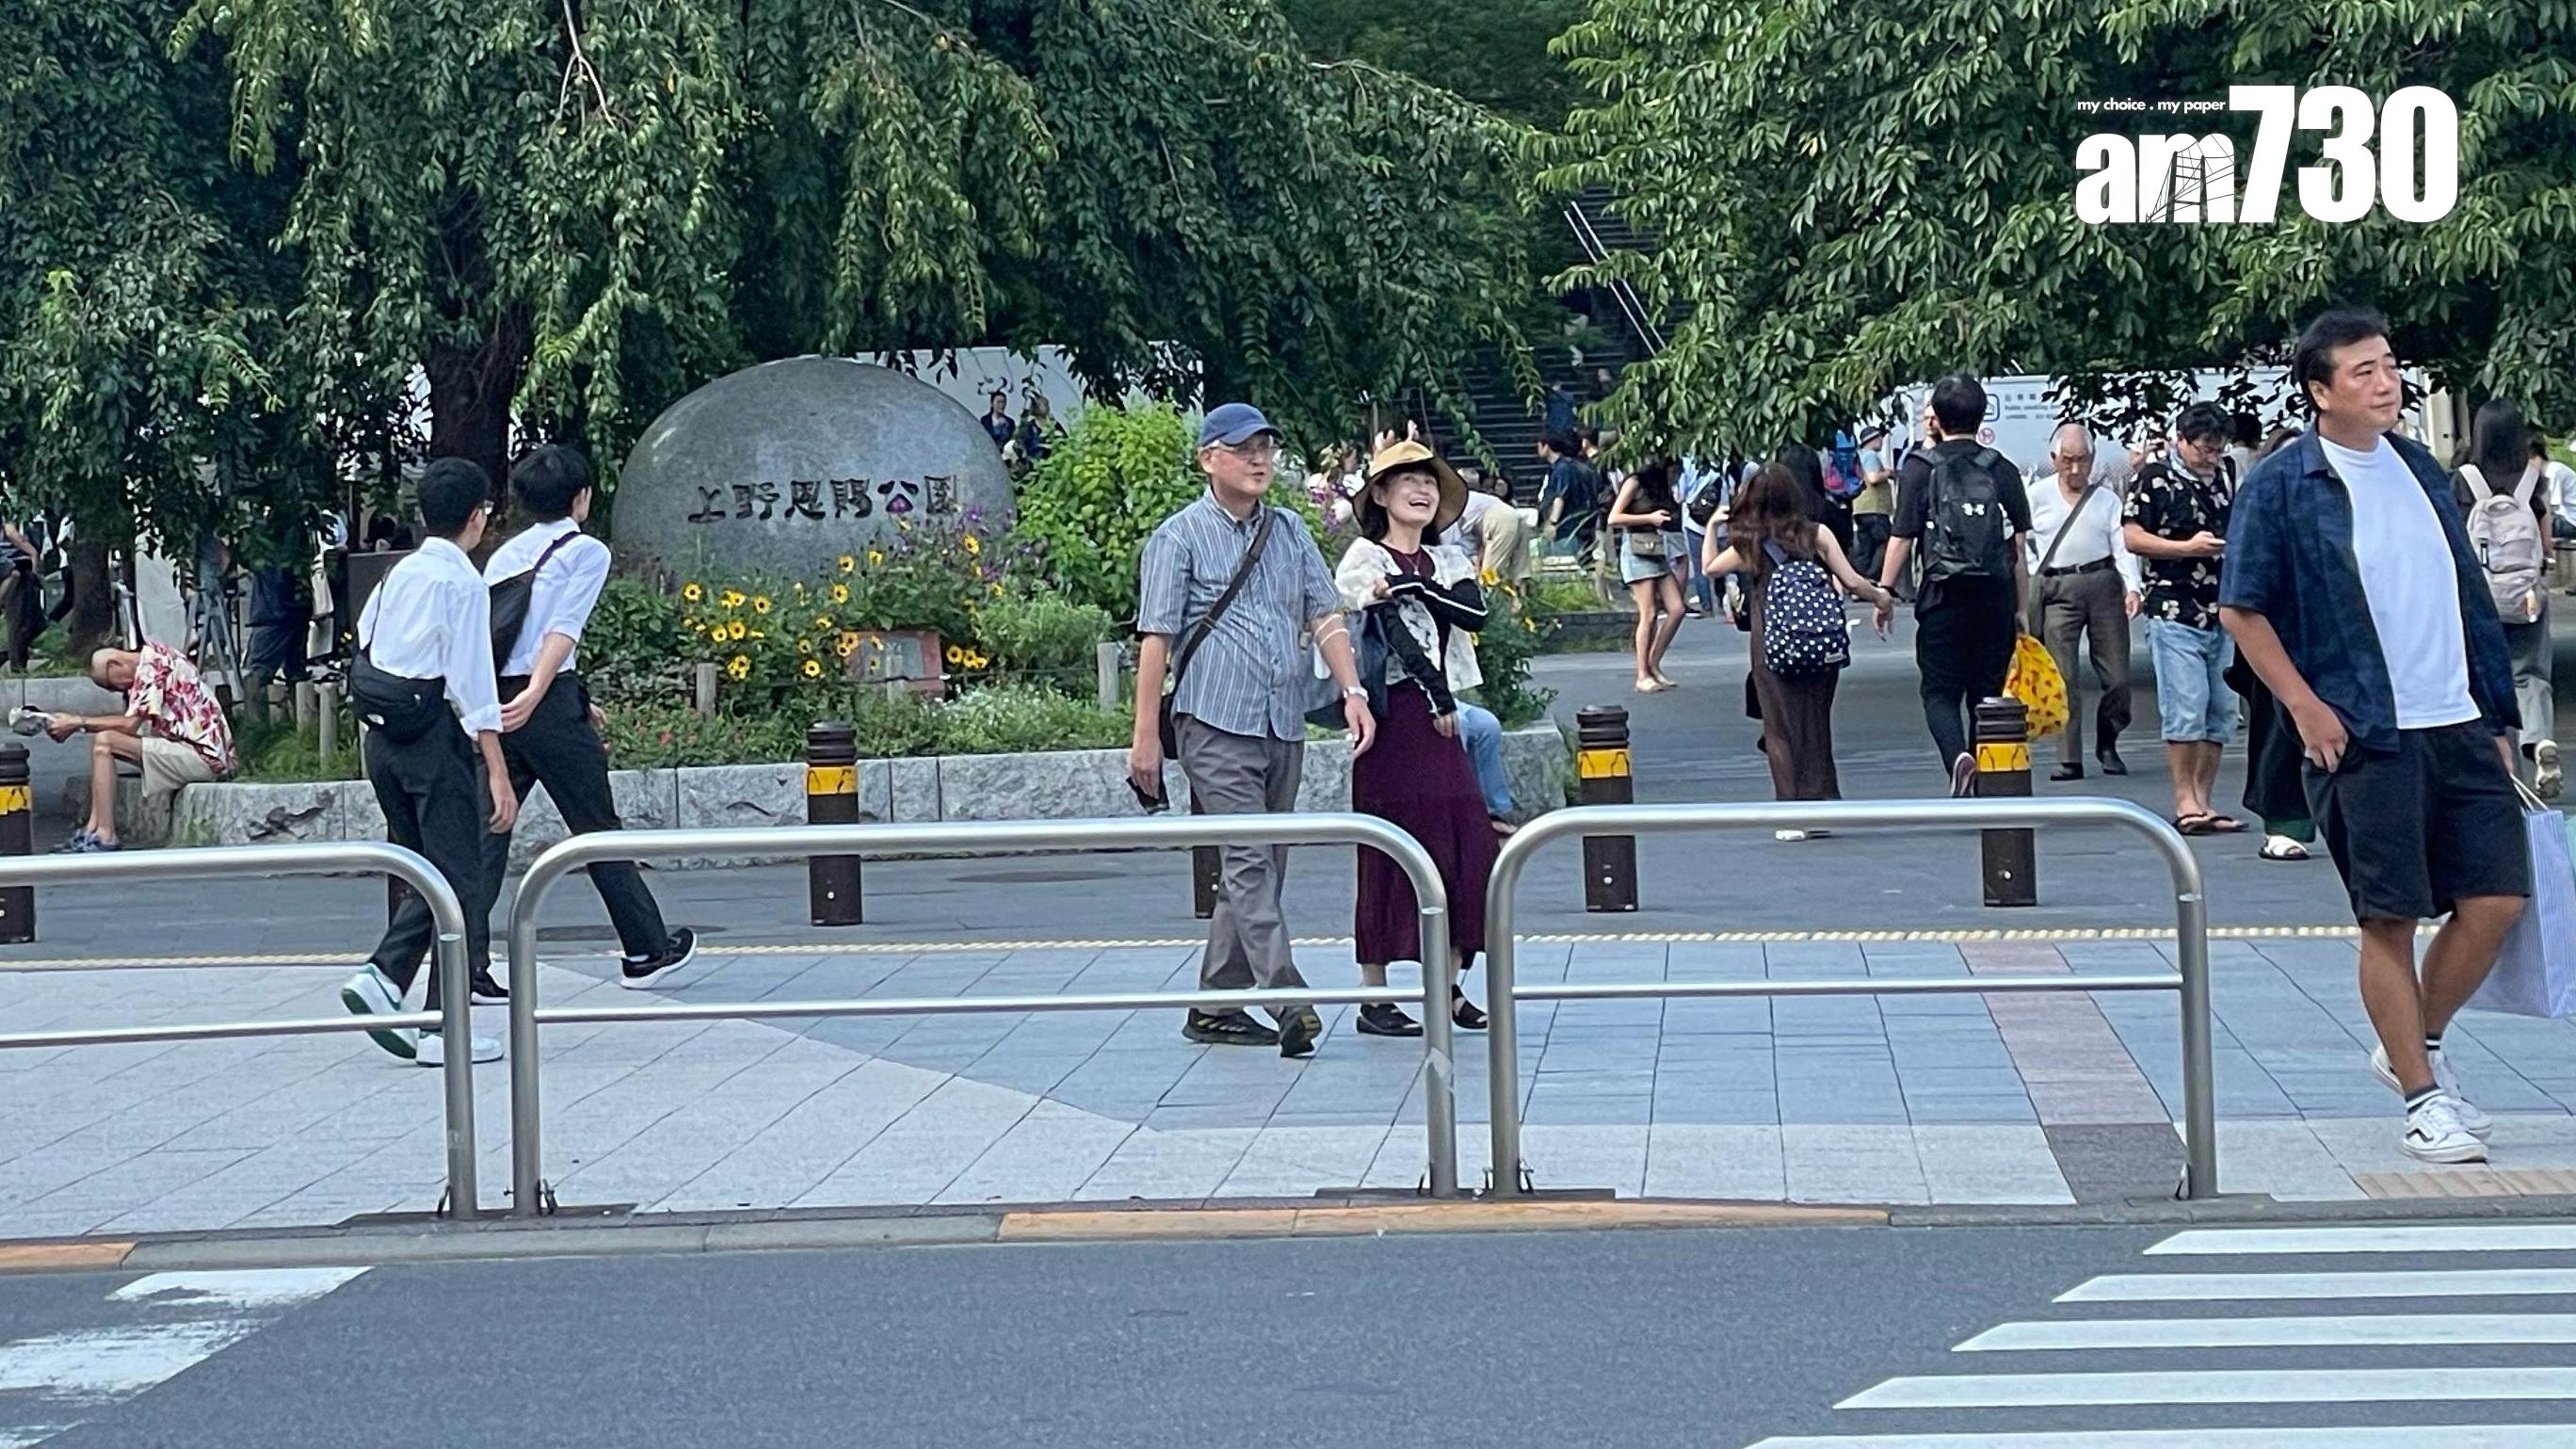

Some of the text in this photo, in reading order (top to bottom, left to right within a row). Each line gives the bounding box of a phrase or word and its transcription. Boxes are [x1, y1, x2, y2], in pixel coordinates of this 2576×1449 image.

[687, 475, 958, 523] 上野恩賜公園
